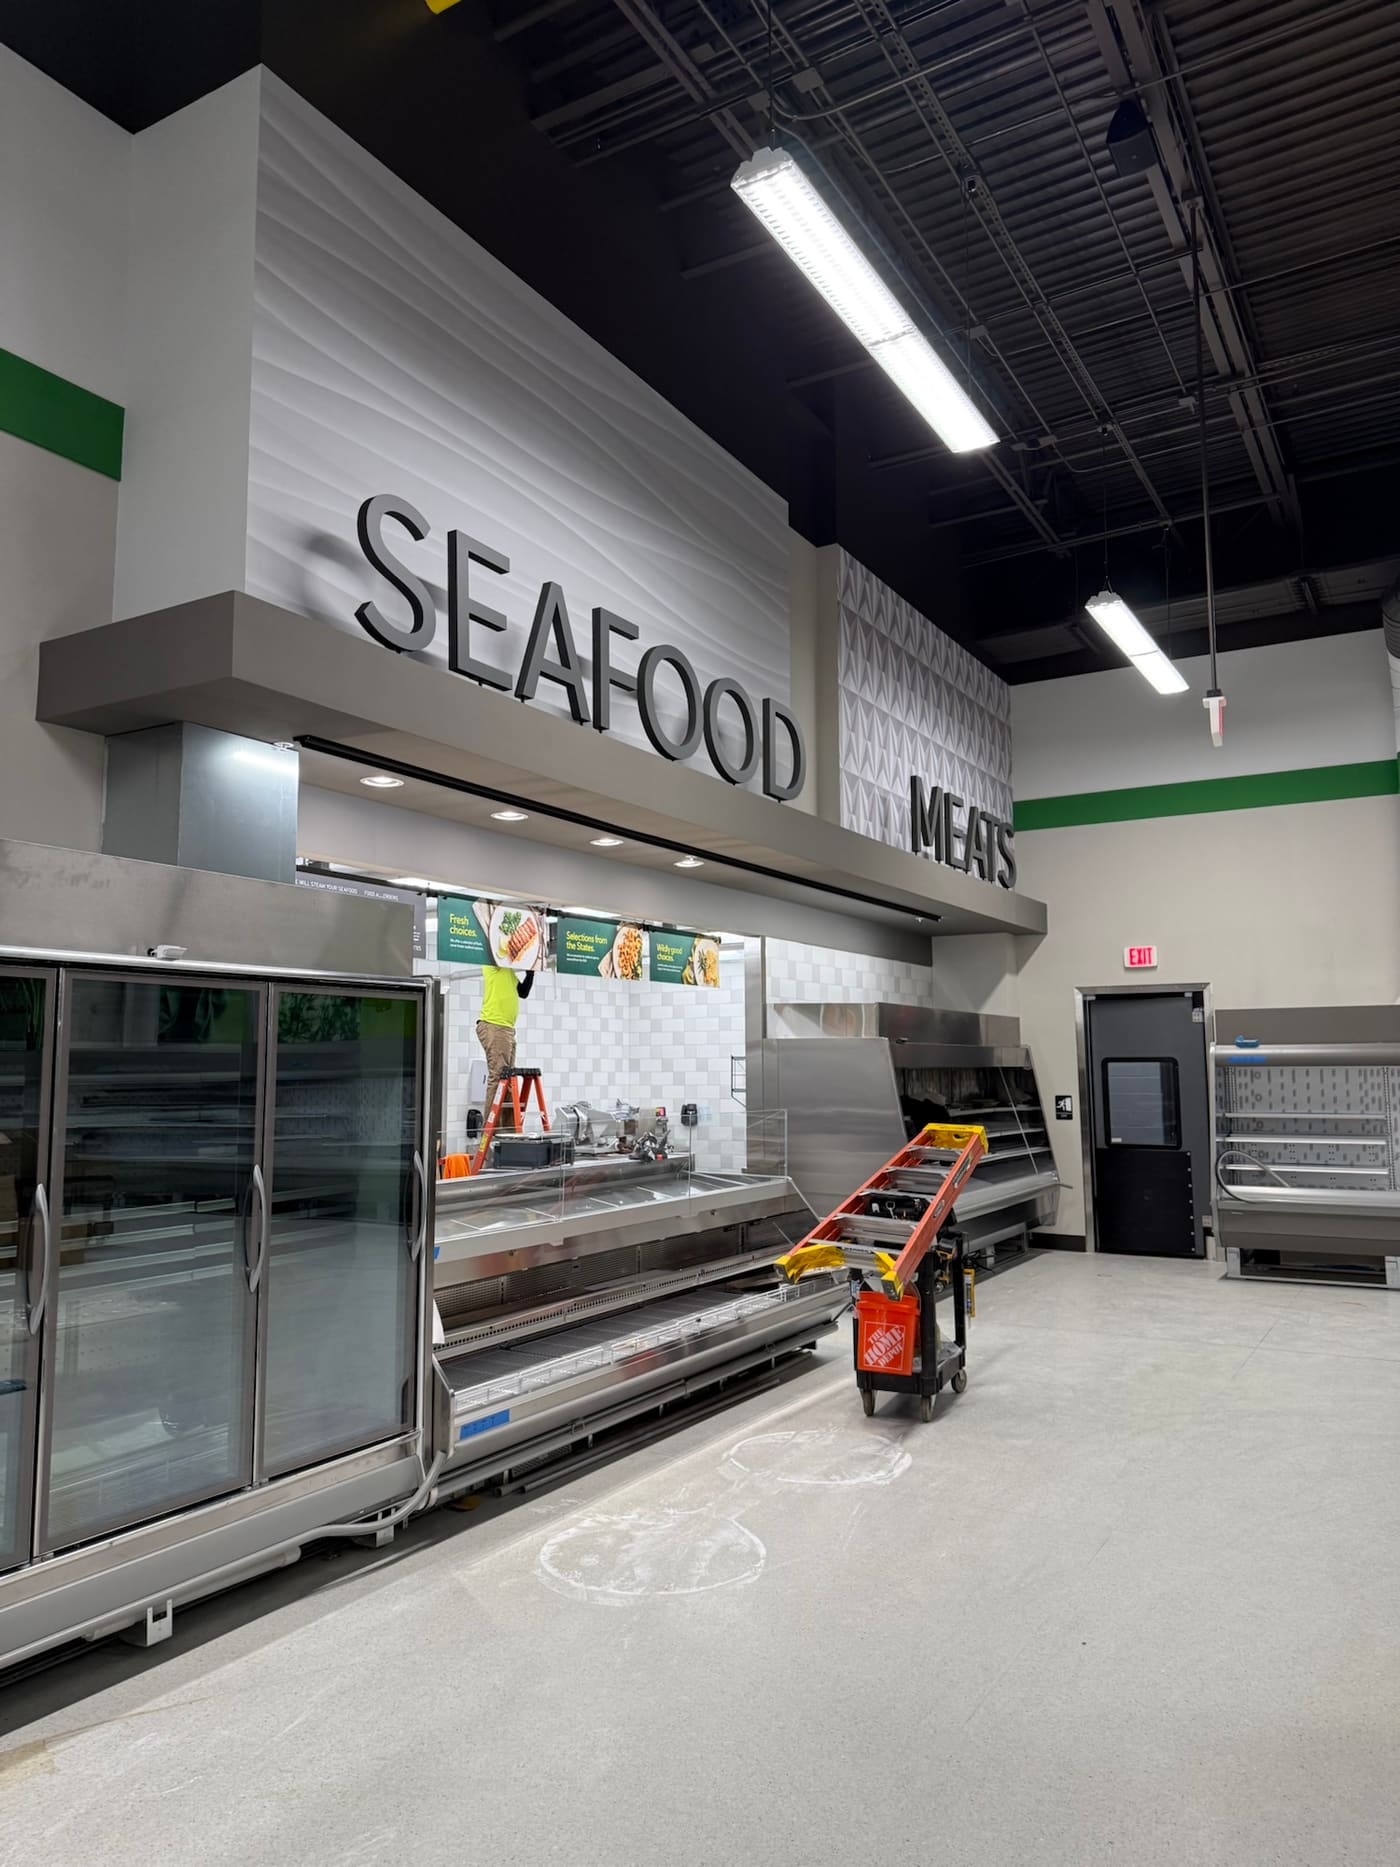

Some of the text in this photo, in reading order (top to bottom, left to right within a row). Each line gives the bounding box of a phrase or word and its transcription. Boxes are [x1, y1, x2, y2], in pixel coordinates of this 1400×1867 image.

[354, 493, 806, 802] SEAFOOD
[910, 775, 1017, 889] MEATS
[450, 913, 469, 926] Fresh
[450, 925, 478, 937] choices.
[566, 930, 608, 945] Selections from
[566, 940, 595, 952] the States.
[656, 943, 683, 956] Wildly good
[1129, 947, 1152, 966] EXIT
[867, 1327, 885, 1345] THE
[863, 1325, 904, 1366] HOME
[878, 1342, 903, 1367] DEPOT
